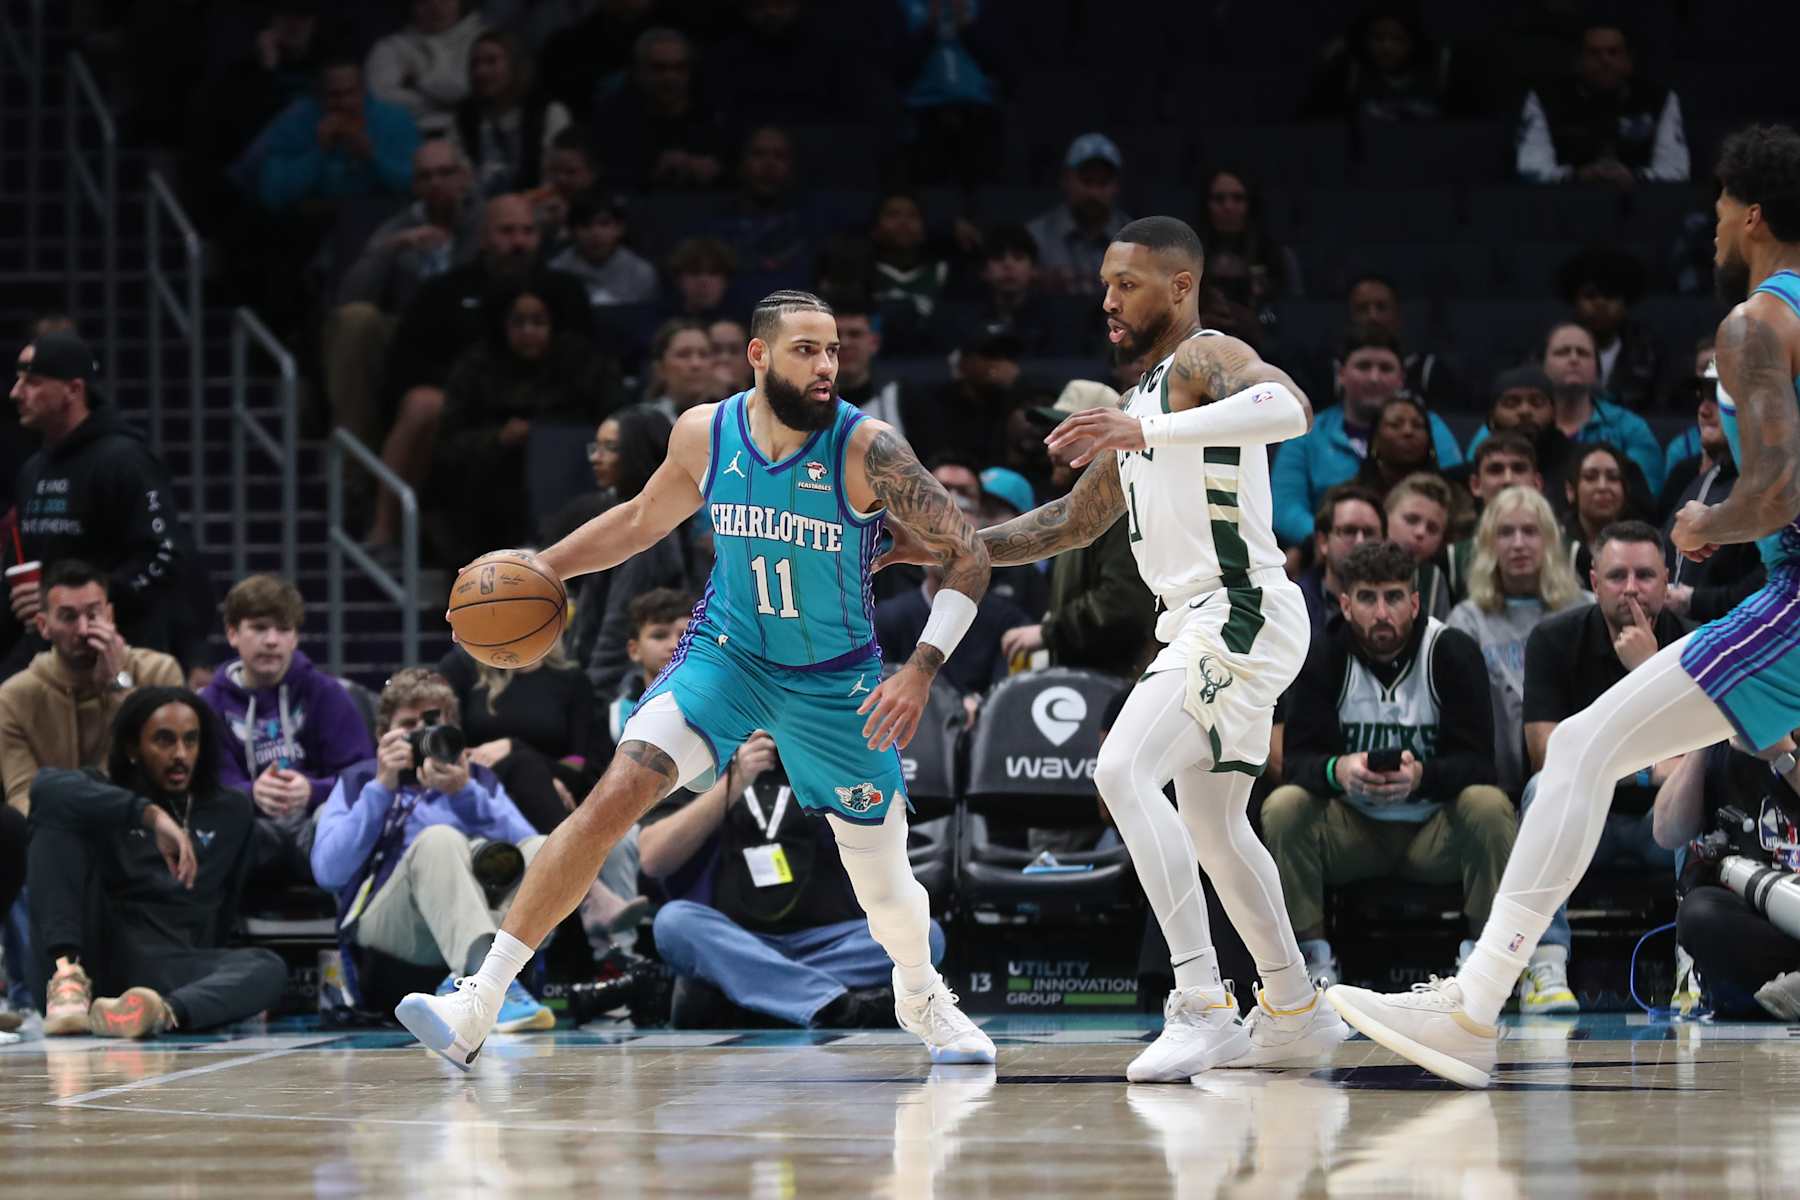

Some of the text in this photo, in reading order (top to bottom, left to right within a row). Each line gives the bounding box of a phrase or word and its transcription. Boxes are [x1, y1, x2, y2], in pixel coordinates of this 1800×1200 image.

[711, 503, 843, 553] CHARLOTTE
[751, 555, 800, 619] 11
[1342, 722, 1439, 762] BUCKS
[1007, 960, 1090, 976] UTILITY
[969, 971, 993, 993] 13
[1033, 977, 1139, 992] INNOVATION
[1006, 993, 1062, 1006] GROUP
